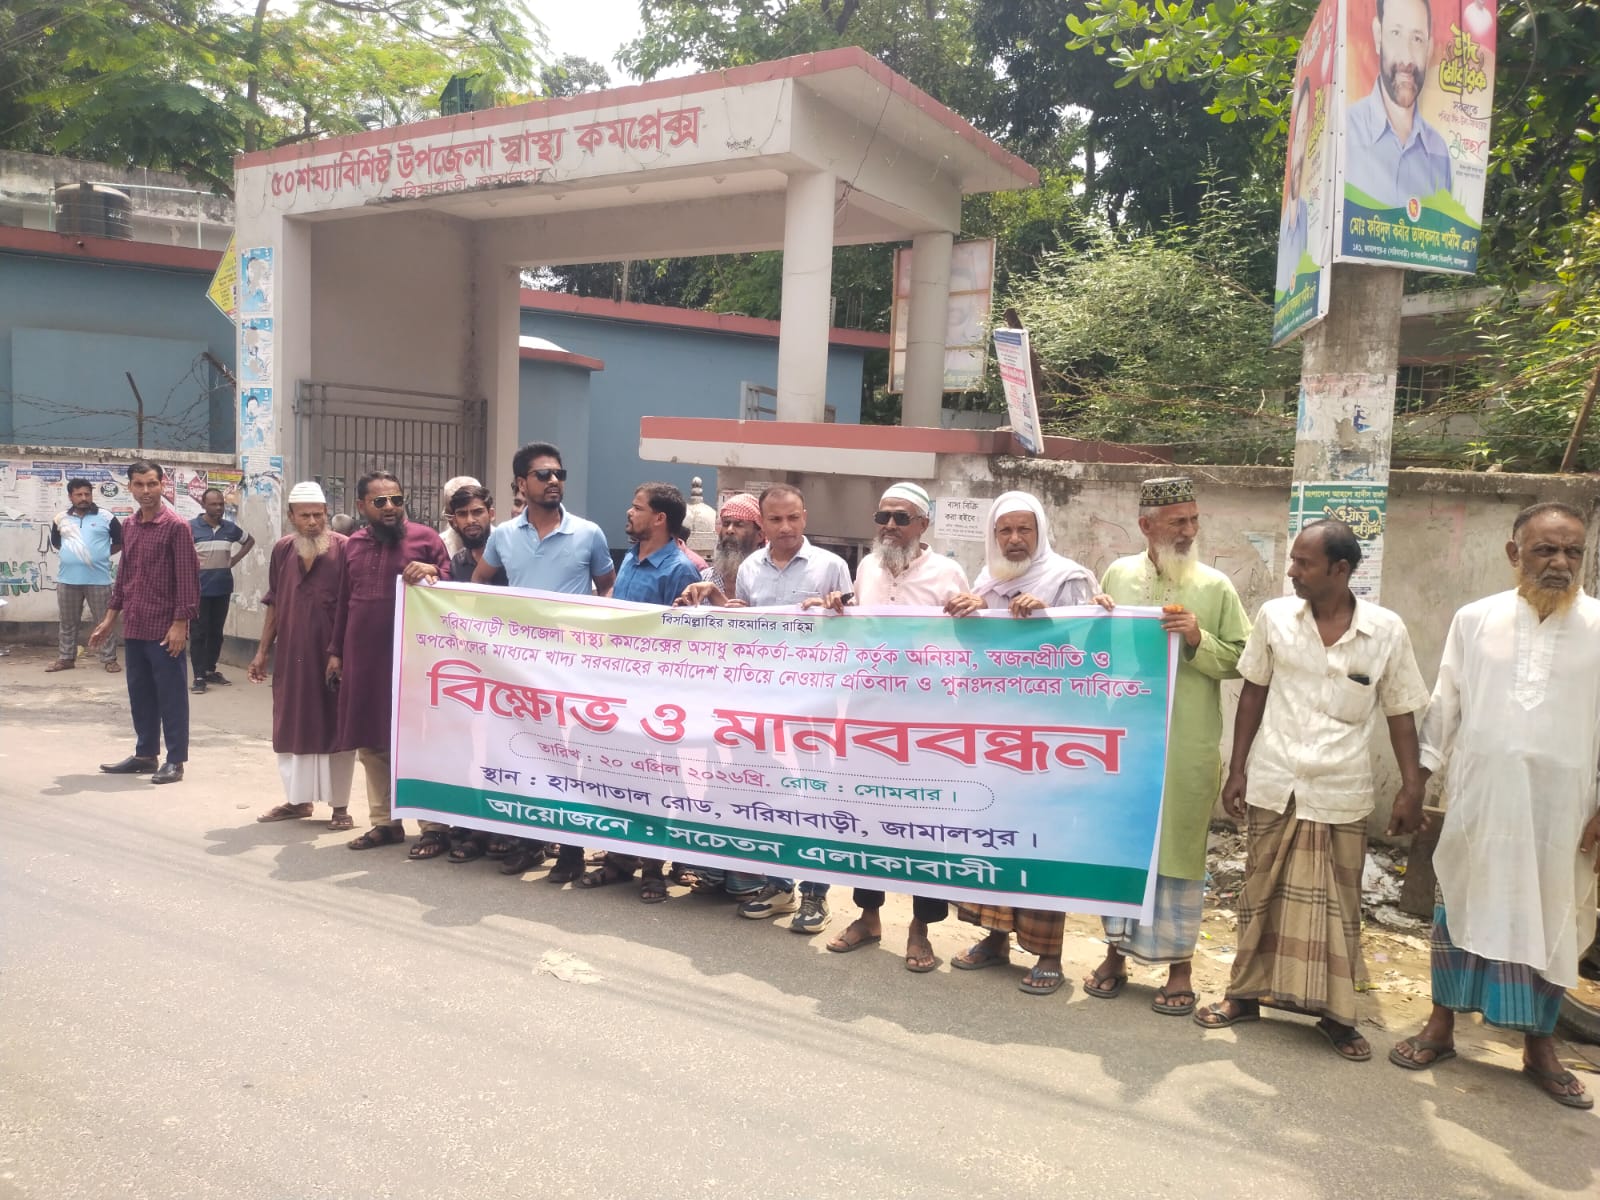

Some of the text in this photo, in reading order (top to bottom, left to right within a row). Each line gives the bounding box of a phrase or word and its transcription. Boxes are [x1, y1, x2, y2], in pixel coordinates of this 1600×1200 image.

[396, 134, 495, 180] উপজেলা
[499, 127, 567, 166] স্বাস্থ্য
[573, 106, 703, 156] কমপ্লেক্স
[508, 620, 564, 643] উপজেলা
[569, 628, 605, 649] স্বাস্থ্য
[609, 633, 682, 655] কমপ্লেক্সের
[688, 640, 728, 661] অসাধু
[855, 642, 898, 674] কর্তৃক
[985, 643, 1087, 669] স্বজনপ্রীতি
[1093, 652, 1110, 669] ও
[728, 617, 777, 631] রাহমানির
[782, 619, 815, 633] রাহিম
[492, 643, 541, 662] মাধ্যমে
[581, 654, 653, 675] সরবরাহের
[657, 658, 719, 680] কার্যাদেশ
[723, 662, 775, 684] হাতিয়ে
[779, 670, 837, 689] নেওয়ার
[841, 670, 908, 694] প্রতিবাদ
[917, 676, 932, 692] ও
[426, 658, 1127, 775] বিক্ষোভ ও মানববন্ধন
[537, 741, 582, 763] তারিখ
[599, 755, 624, 773] ২০
[631, 756, 681, 779] এপ্রিল
[780, 774, 830, 793] রোজ
[854, 781, 944, 803] সোমবার
[479, 765, 522, 786] স্থান
[547, 774, 652, 807] হাসপাতাল
[880, 820, 1019, 850] জামালপুর
[485, 797, 633, 837] আয়োজনে
[665, 825, 785, 858] সচেতন
[797, 845, 1003, 886] এলাকাবাসী
